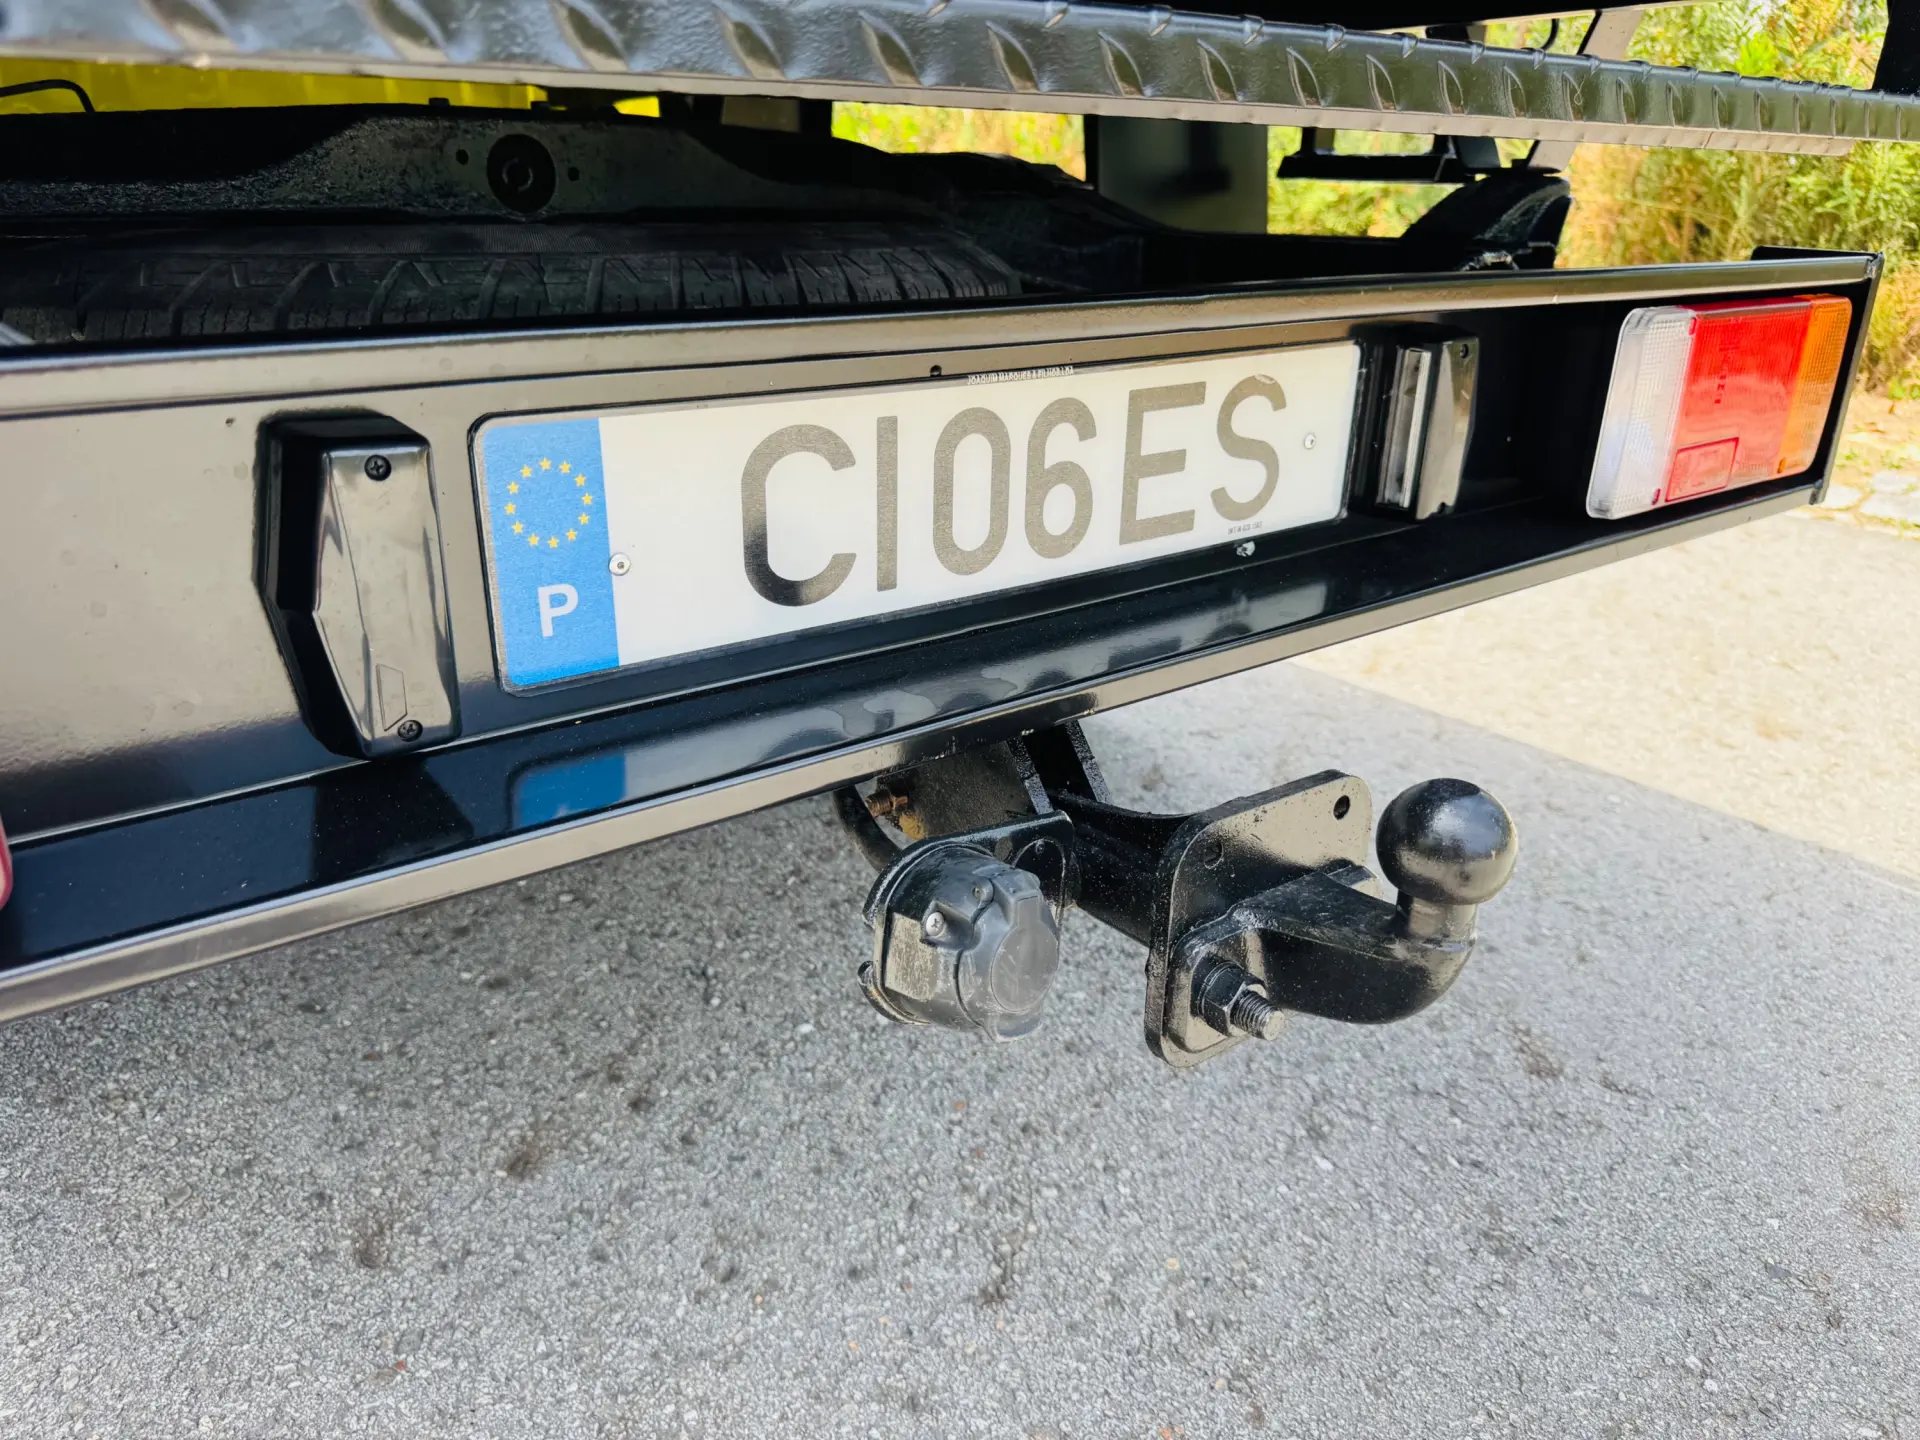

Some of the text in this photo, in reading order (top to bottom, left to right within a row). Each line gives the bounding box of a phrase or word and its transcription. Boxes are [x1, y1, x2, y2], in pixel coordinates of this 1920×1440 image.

[967, 372, 998, 385] JOAQUIM
[999, 370, 1031, 382] MARQUES
[538, 583, 578, 637] P
